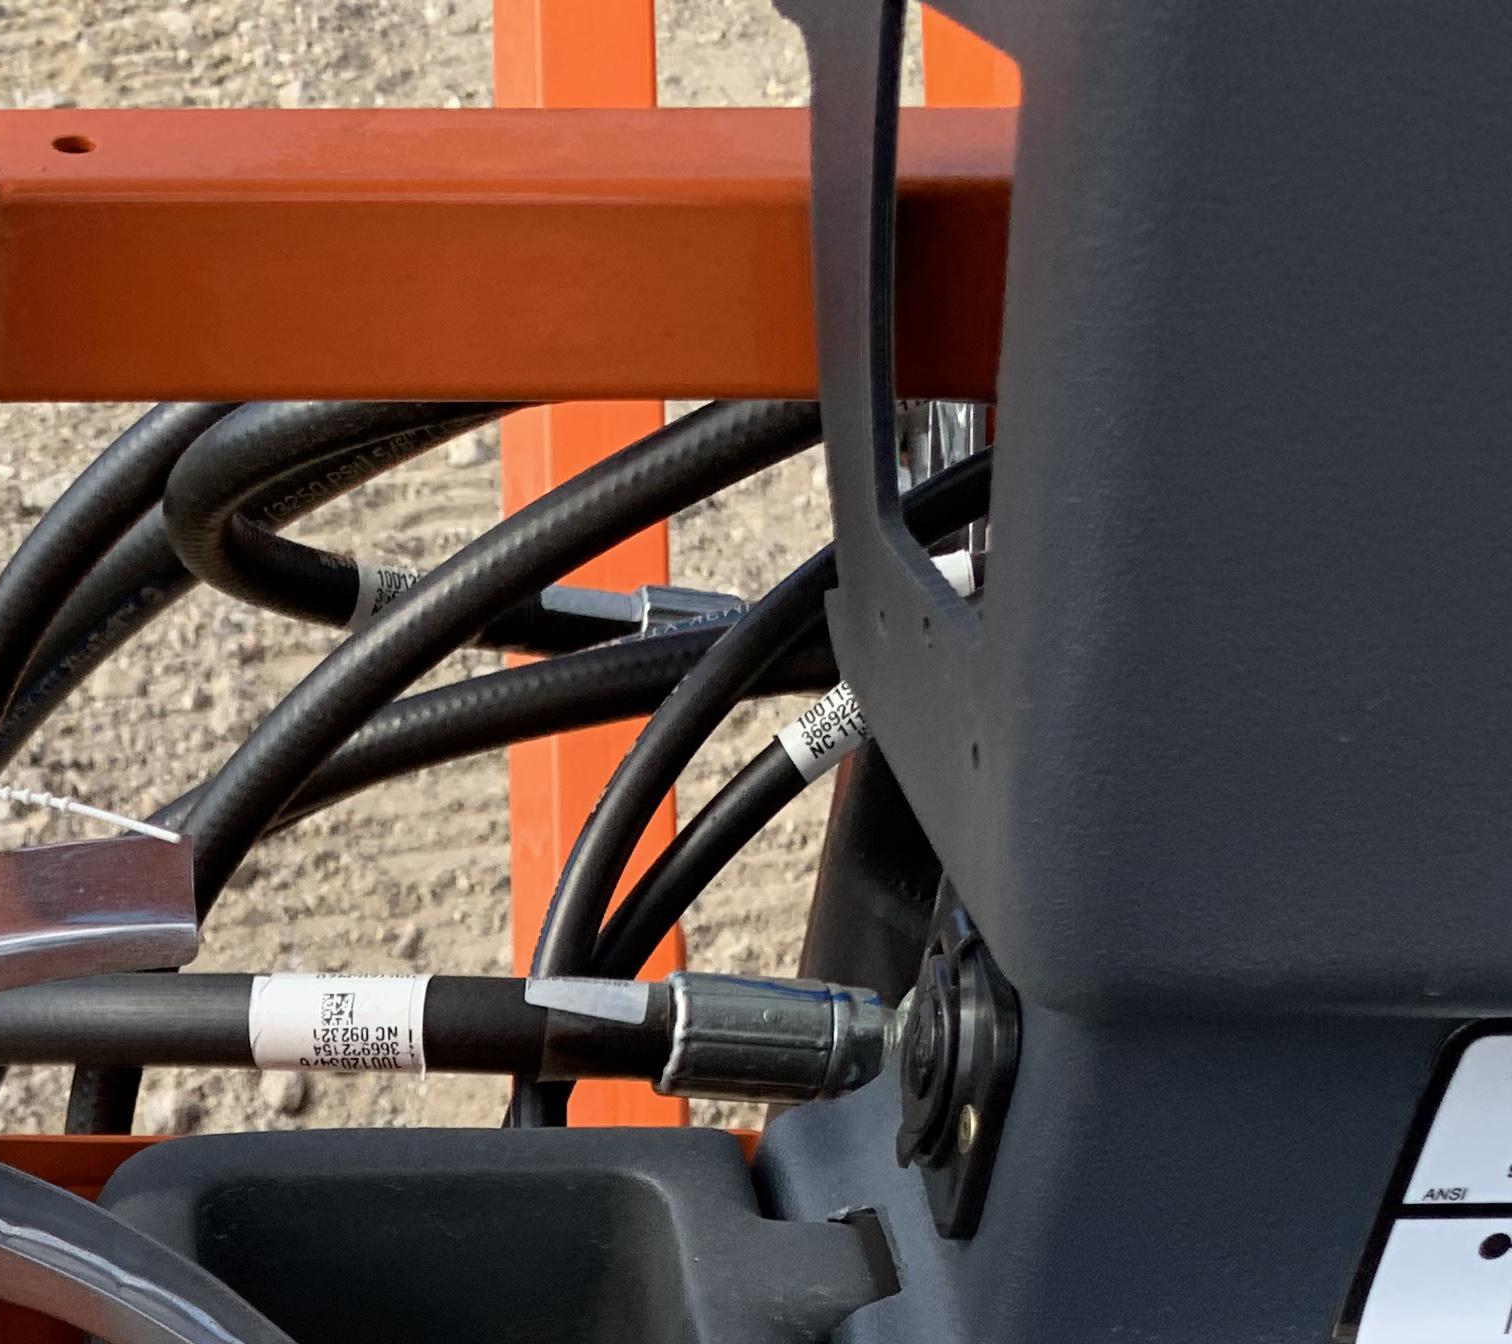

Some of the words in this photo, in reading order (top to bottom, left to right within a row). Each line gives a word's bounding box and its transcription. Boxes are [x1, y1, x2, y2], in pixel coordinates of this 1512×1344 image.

[809, 734, 835, 759] NC
[313, 1027, 369, 1043] 092321
[375, 1026, 398, 1042] NC
[1423, 1187, 1468, 1201] ANSI
